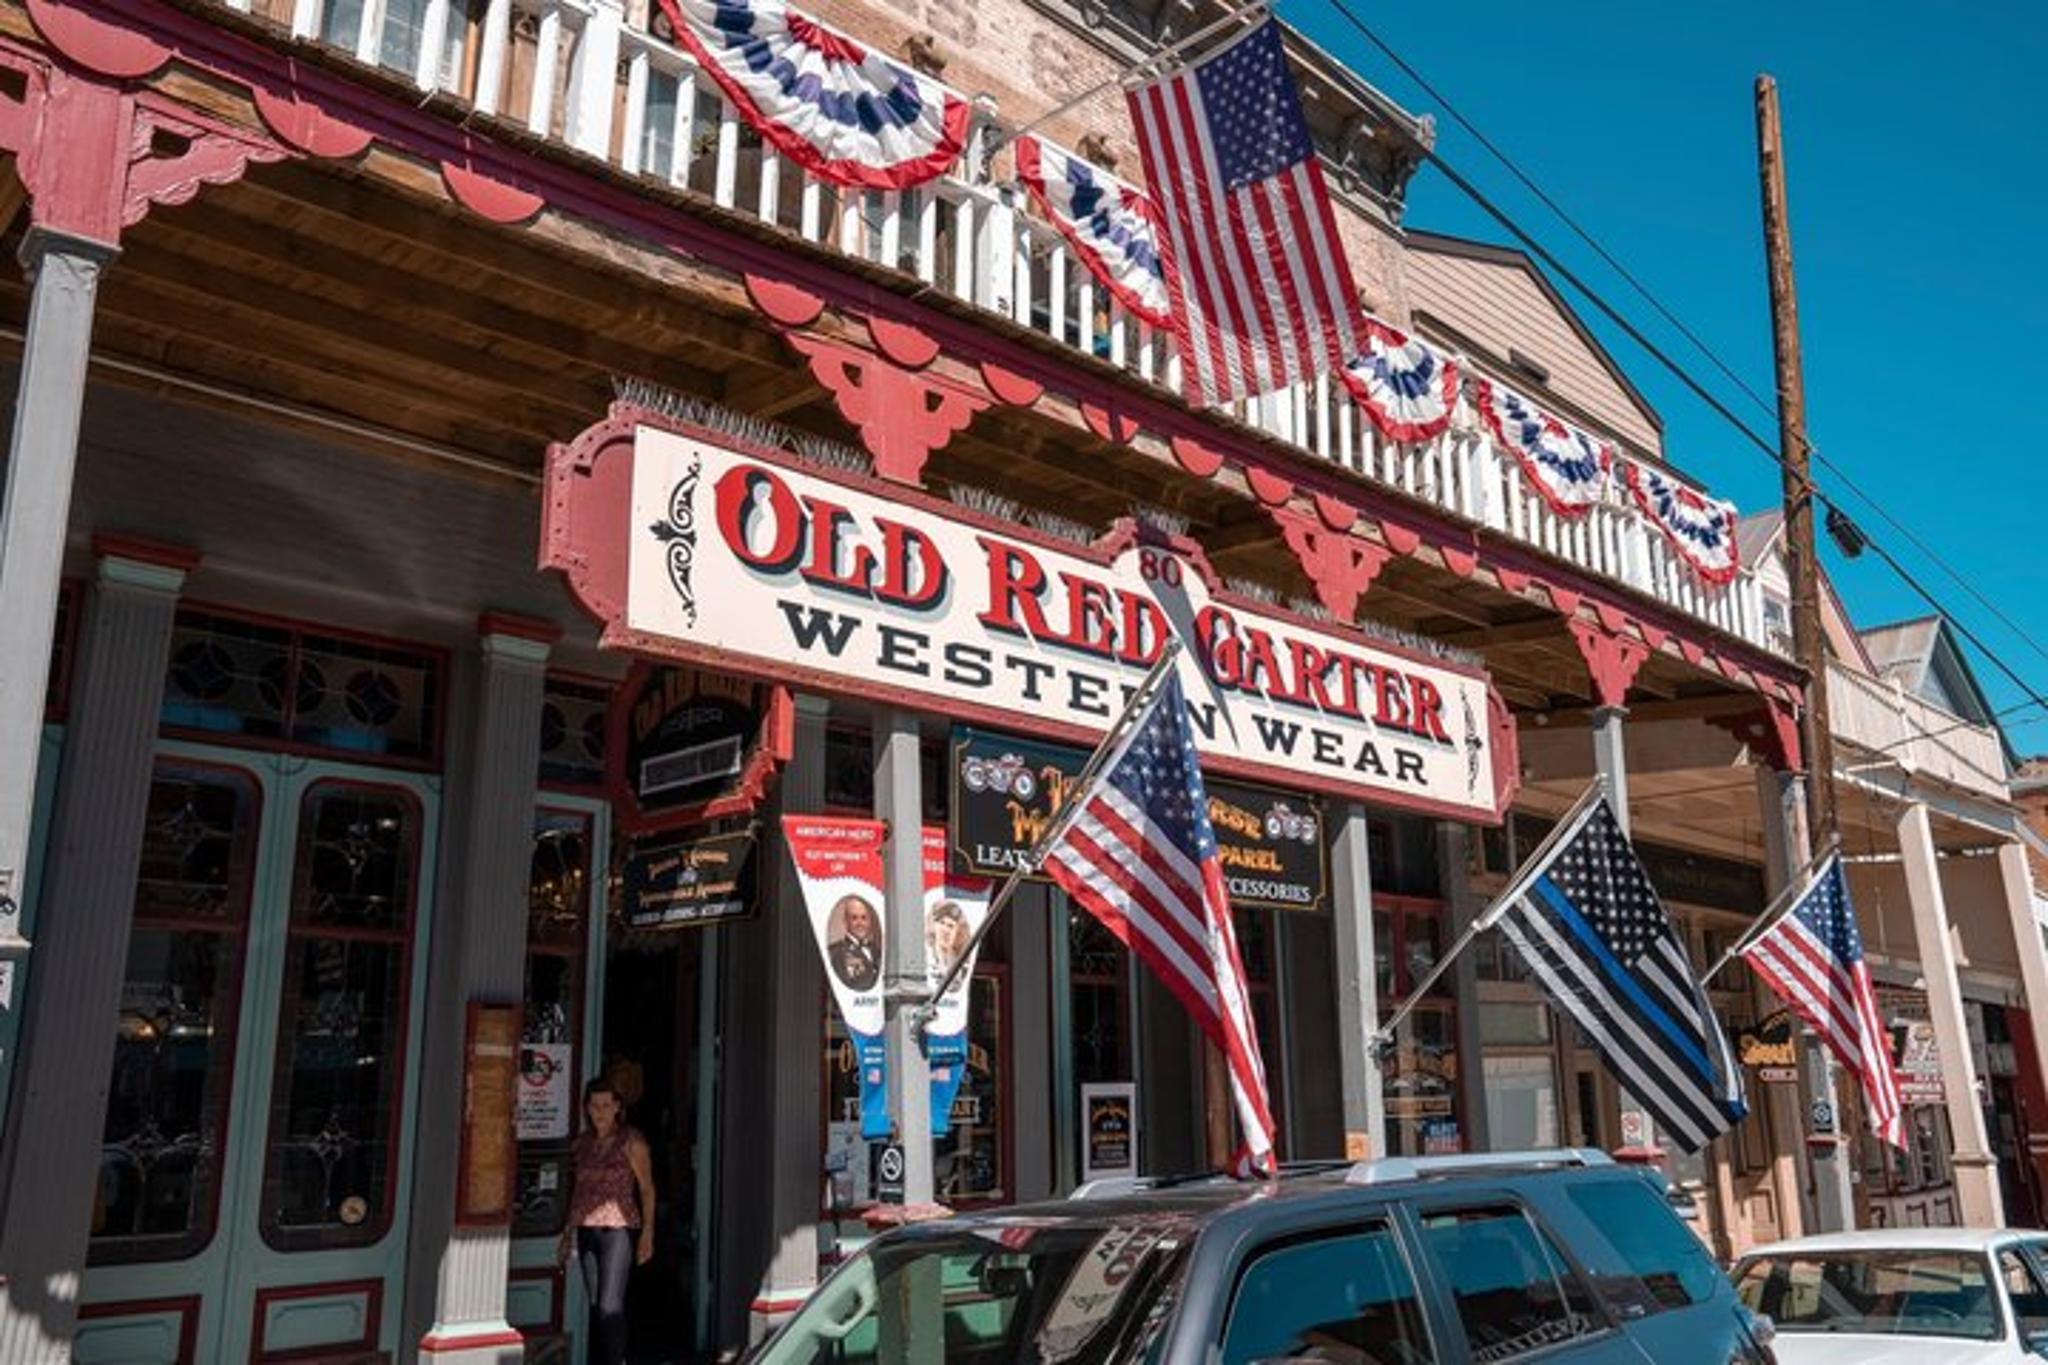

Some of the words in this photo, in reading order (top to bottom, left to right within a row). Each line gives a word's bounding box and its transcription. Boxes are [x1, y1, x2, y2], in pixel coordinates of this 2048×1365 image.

[1140, 548, 1183, 589] 80
[714, 462, 949, 611] OLD
[977, 535, 1173, 671] RED
[1197, 604, 1454, 747] GARTER
[1252, 714, 1430, 785] WEAR
[976, 843, 1043, 871] LEAT
[1217, 844, 1284, 873] PAREL
[1223, 876, 1312, 902] CESSORIES
